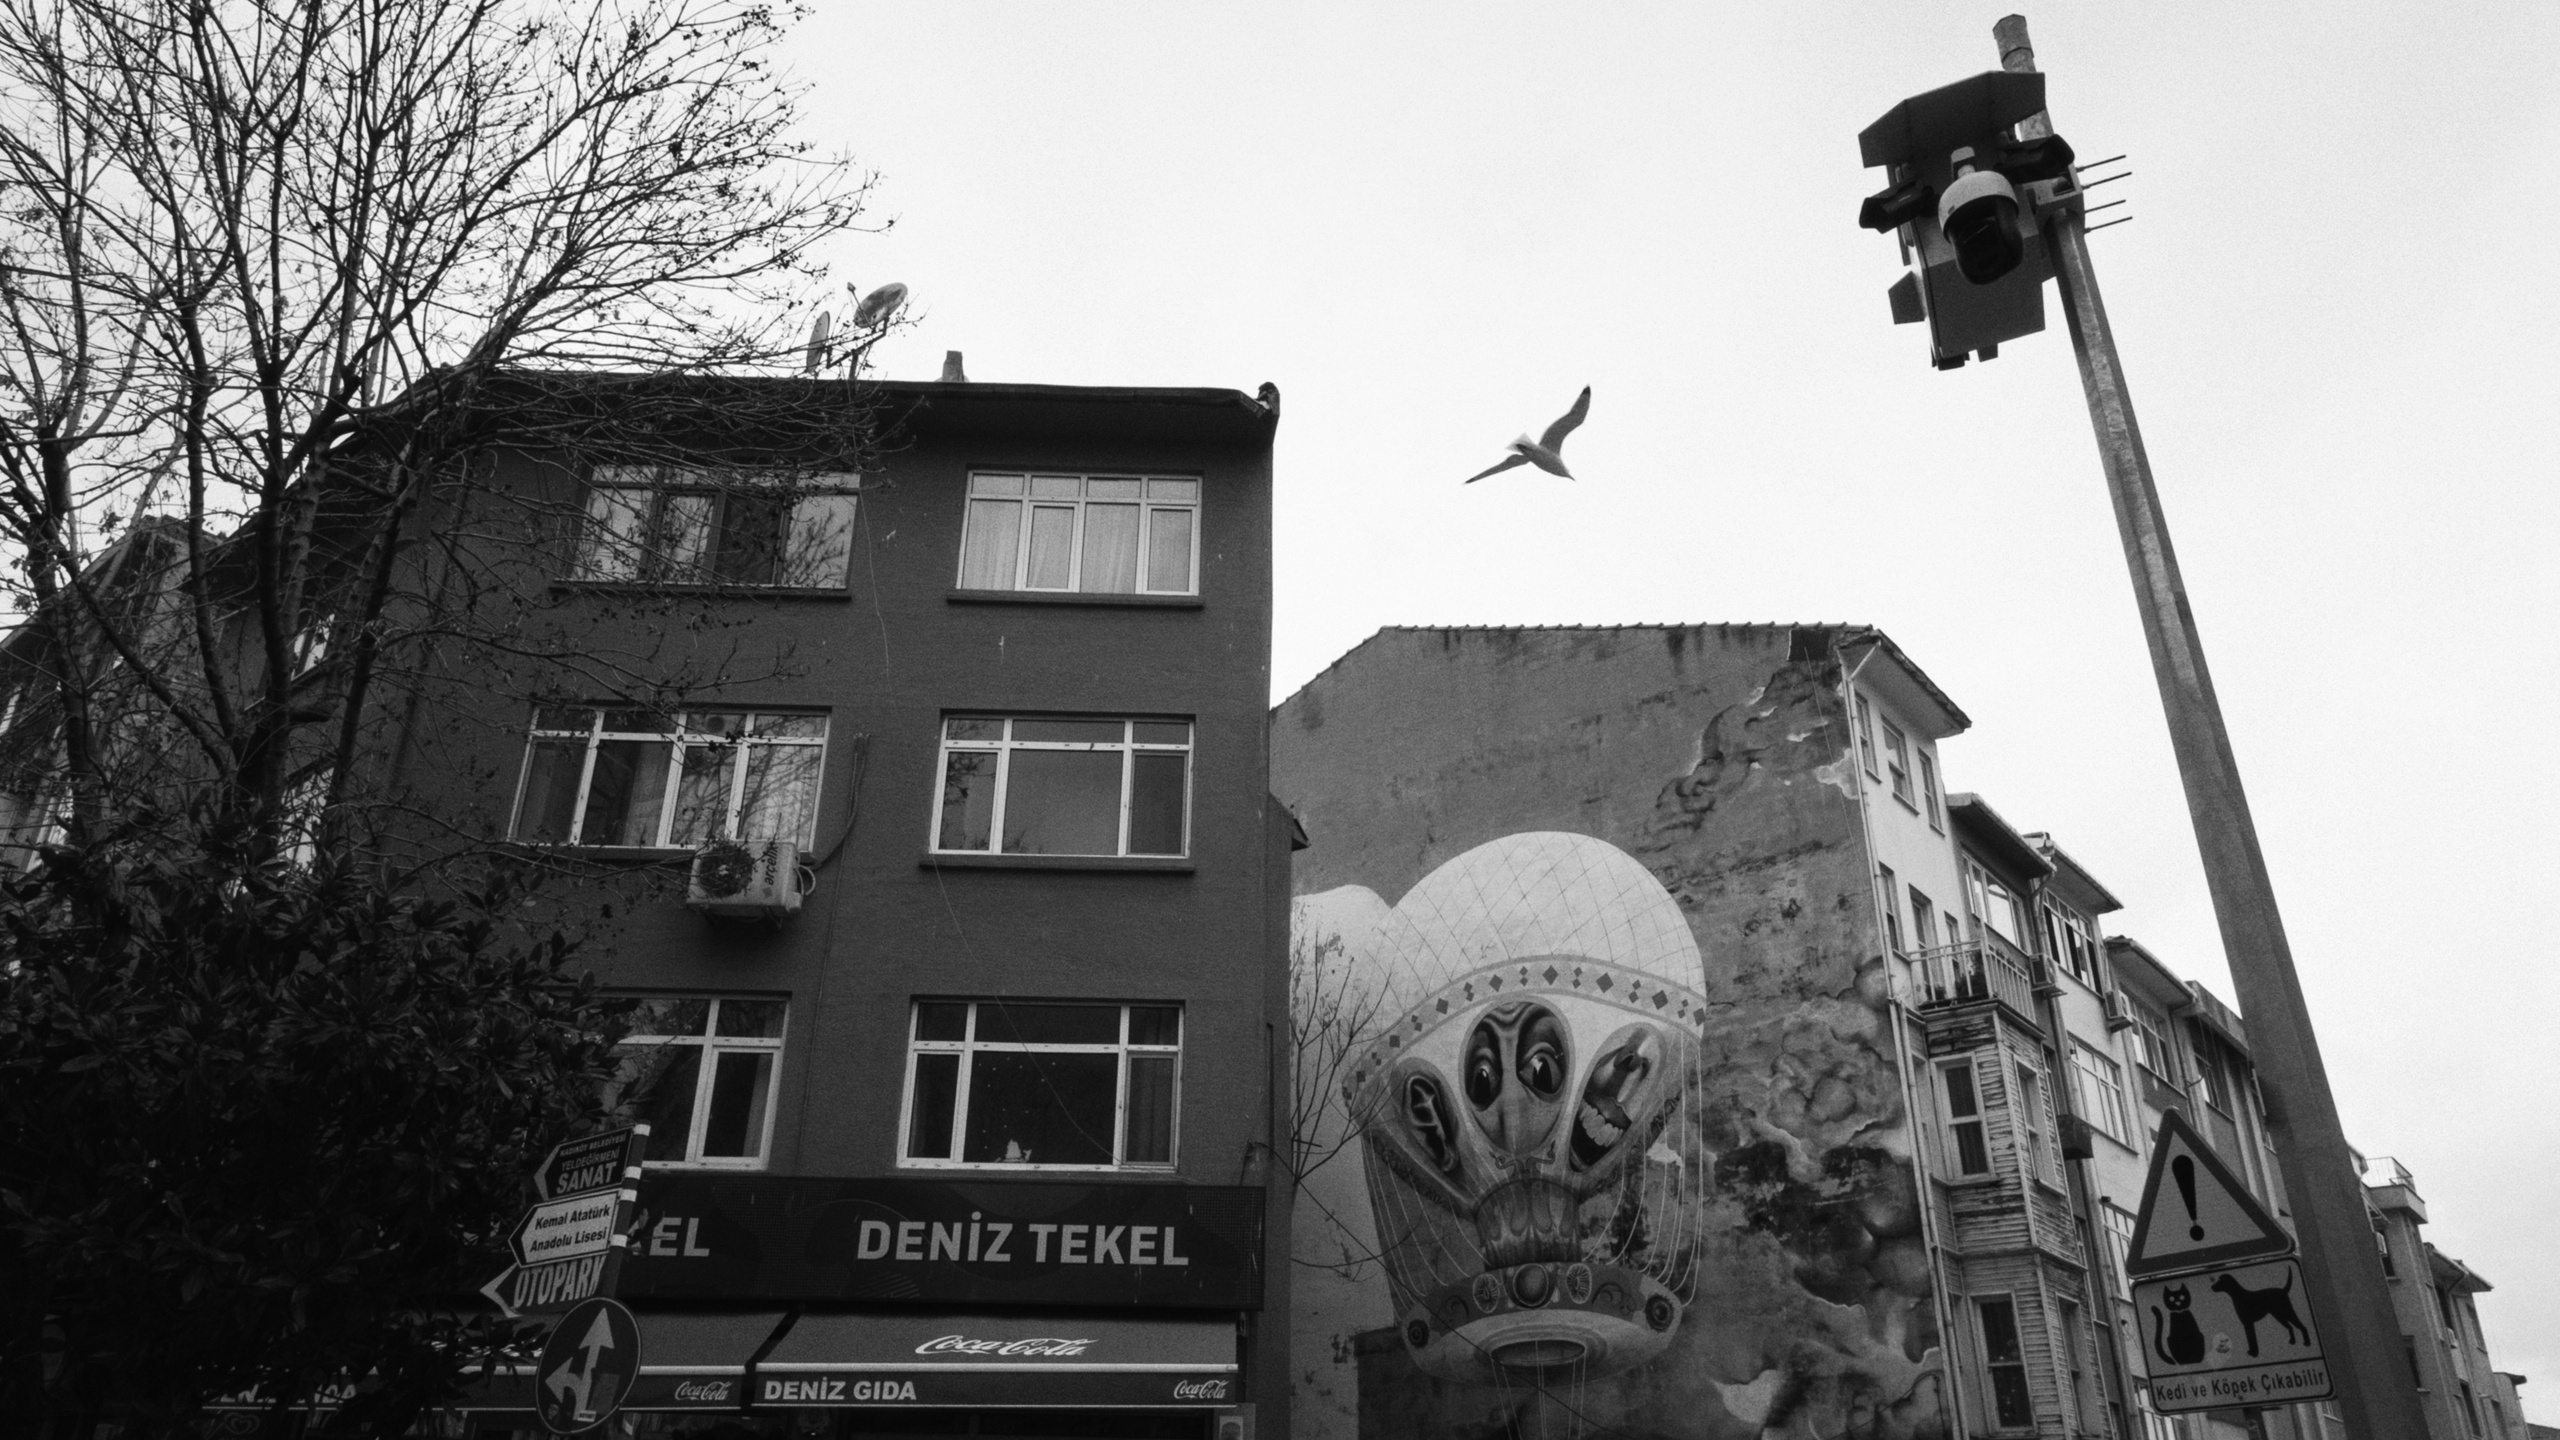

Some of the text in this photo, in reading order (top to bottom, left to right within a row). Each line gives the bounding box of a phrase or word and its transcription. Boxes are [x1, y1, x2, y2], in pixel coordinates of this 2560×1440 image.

[589, 1133, 628, 1152] BELEDİYESİ
[560, 1147, 621, 1171] YELDEĞİRMENİ
[555, 1161, 618, 1194] SANAT
[534, 1204, 611, 1230] Kemal Atatürk
[529, 1226, 608, 1252] Anadolu Lisesi
[857, 1210, 1190, 1266] DENİZ TEKEL
[915, 1334, 1099, 1356] Coca-Cola
[674, 1380, 733, 1401] Coca-Cola
[764, 1376, 917, 1401] DENİZ GIDA
[1173, 1379, 1230, 1400] Coca-Cola
[2156, 1368, 2325, 1401] Kedi ve Köpek Çıkabilir
